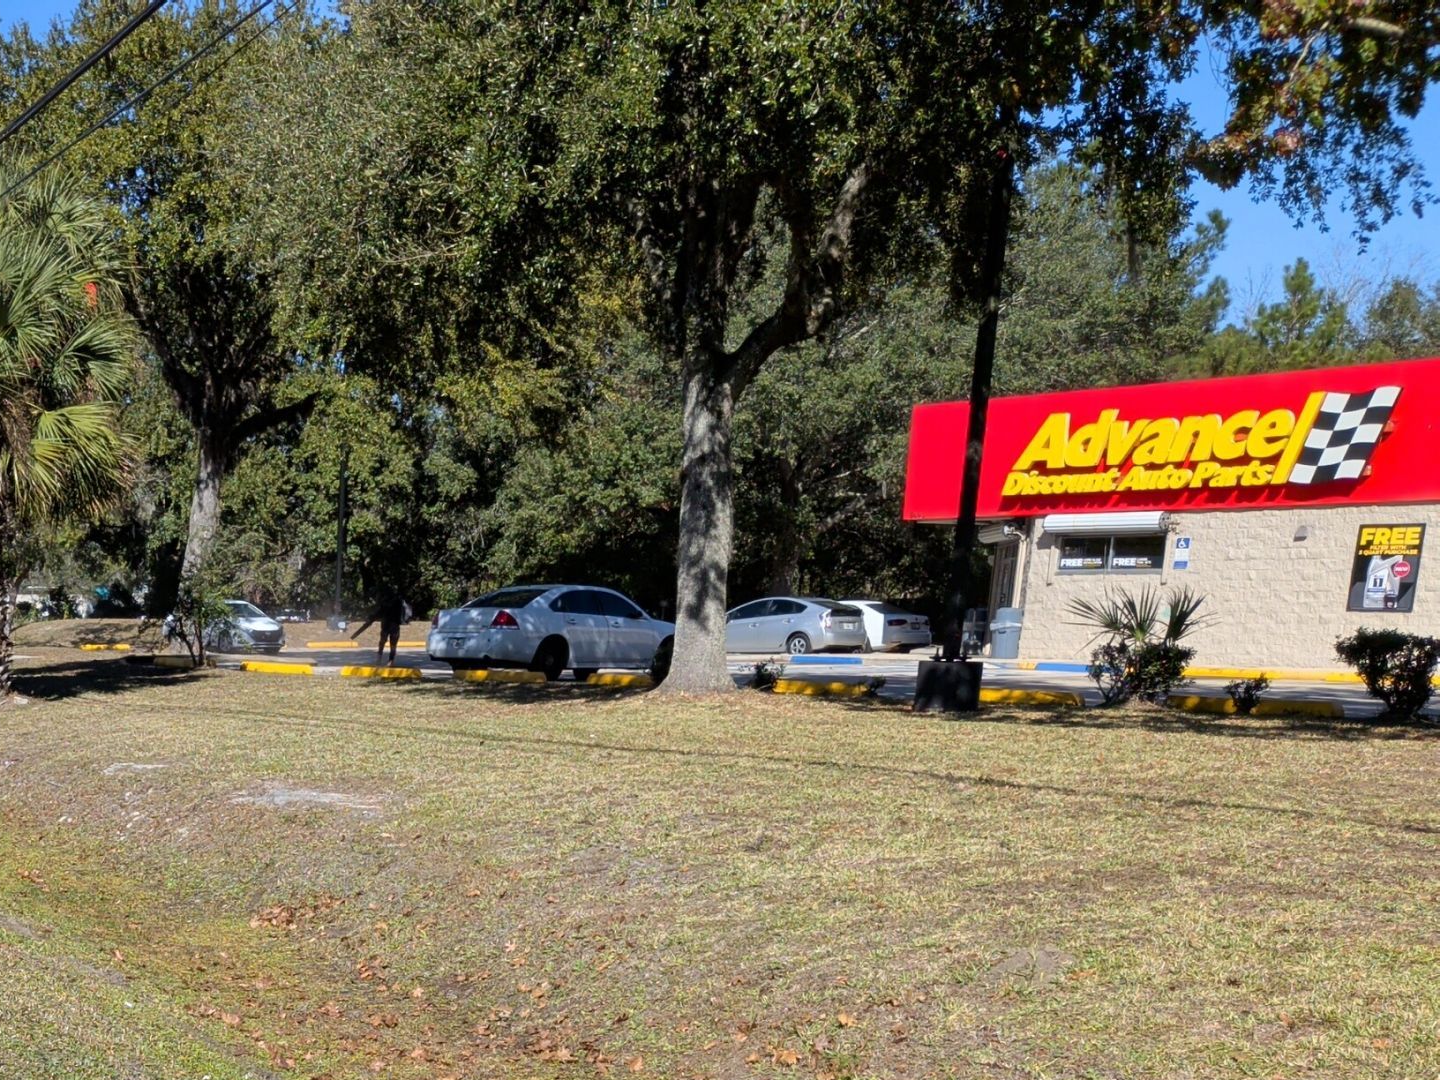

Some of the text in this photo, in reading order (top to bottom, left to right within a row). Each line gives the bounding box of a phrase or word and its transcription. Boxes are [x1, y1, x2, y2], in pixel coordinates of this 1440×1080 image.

[1012, 408, 1296, 471] Advance
[1002, 460, 1276, 496] Discount Auto Parts
[1360, 527, 1422, 546] FREE
[1060, 558, 1083, 567] FREE
[1112, 557, 1136, 567] FREE
